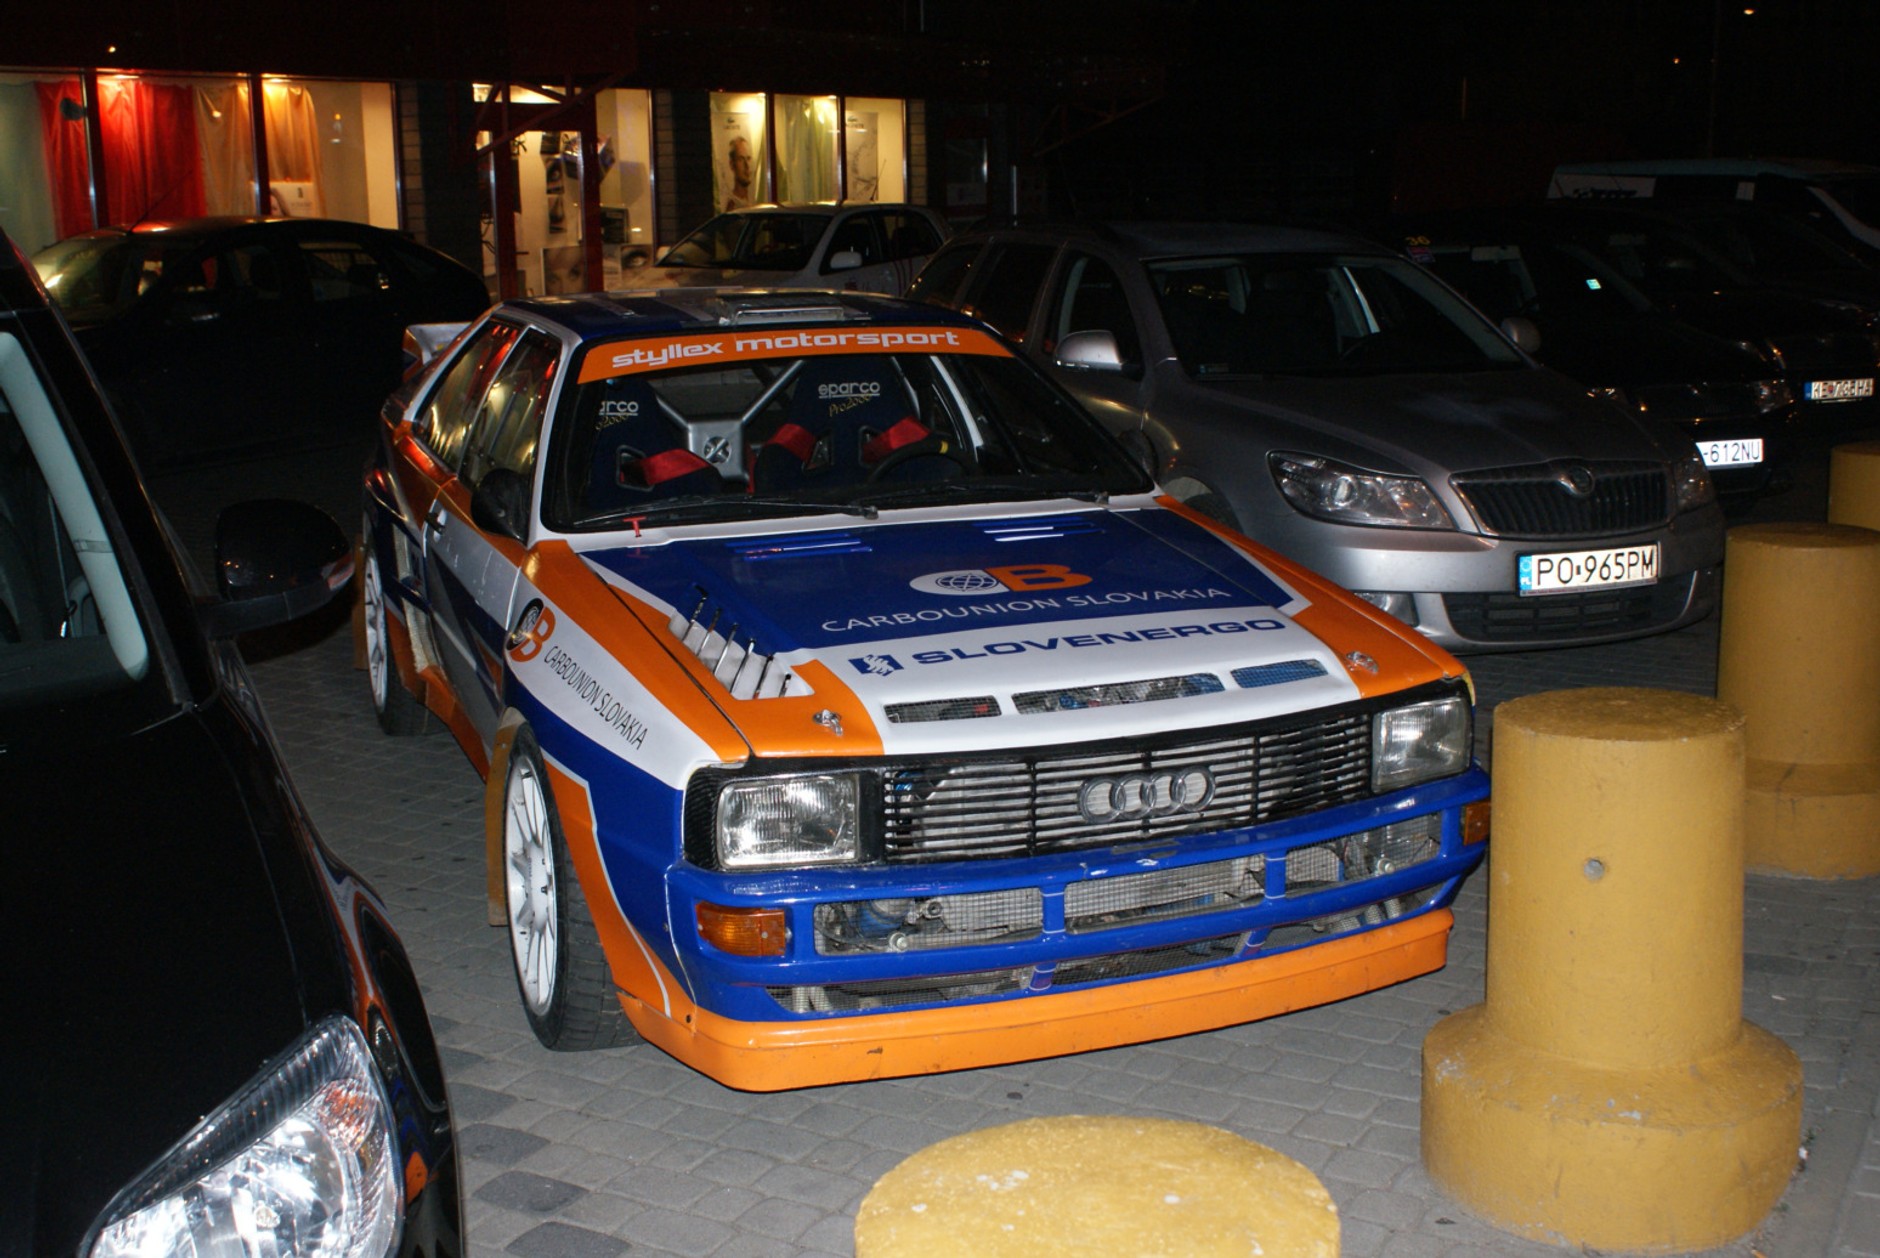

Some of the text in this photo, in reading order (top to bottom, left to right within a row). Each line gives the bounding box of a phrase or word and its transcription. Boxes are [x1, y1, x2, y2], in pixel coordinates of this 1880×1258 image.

[612, 331, 960, 368] styllex motorsport
[821, 587, 1232, 633] CARBOUNION SLOVAKIA
[910, 618, 1287, 665] SLOVENERGO
[543, 645, 648, 750] CARBOUNION SLOVAKIA
